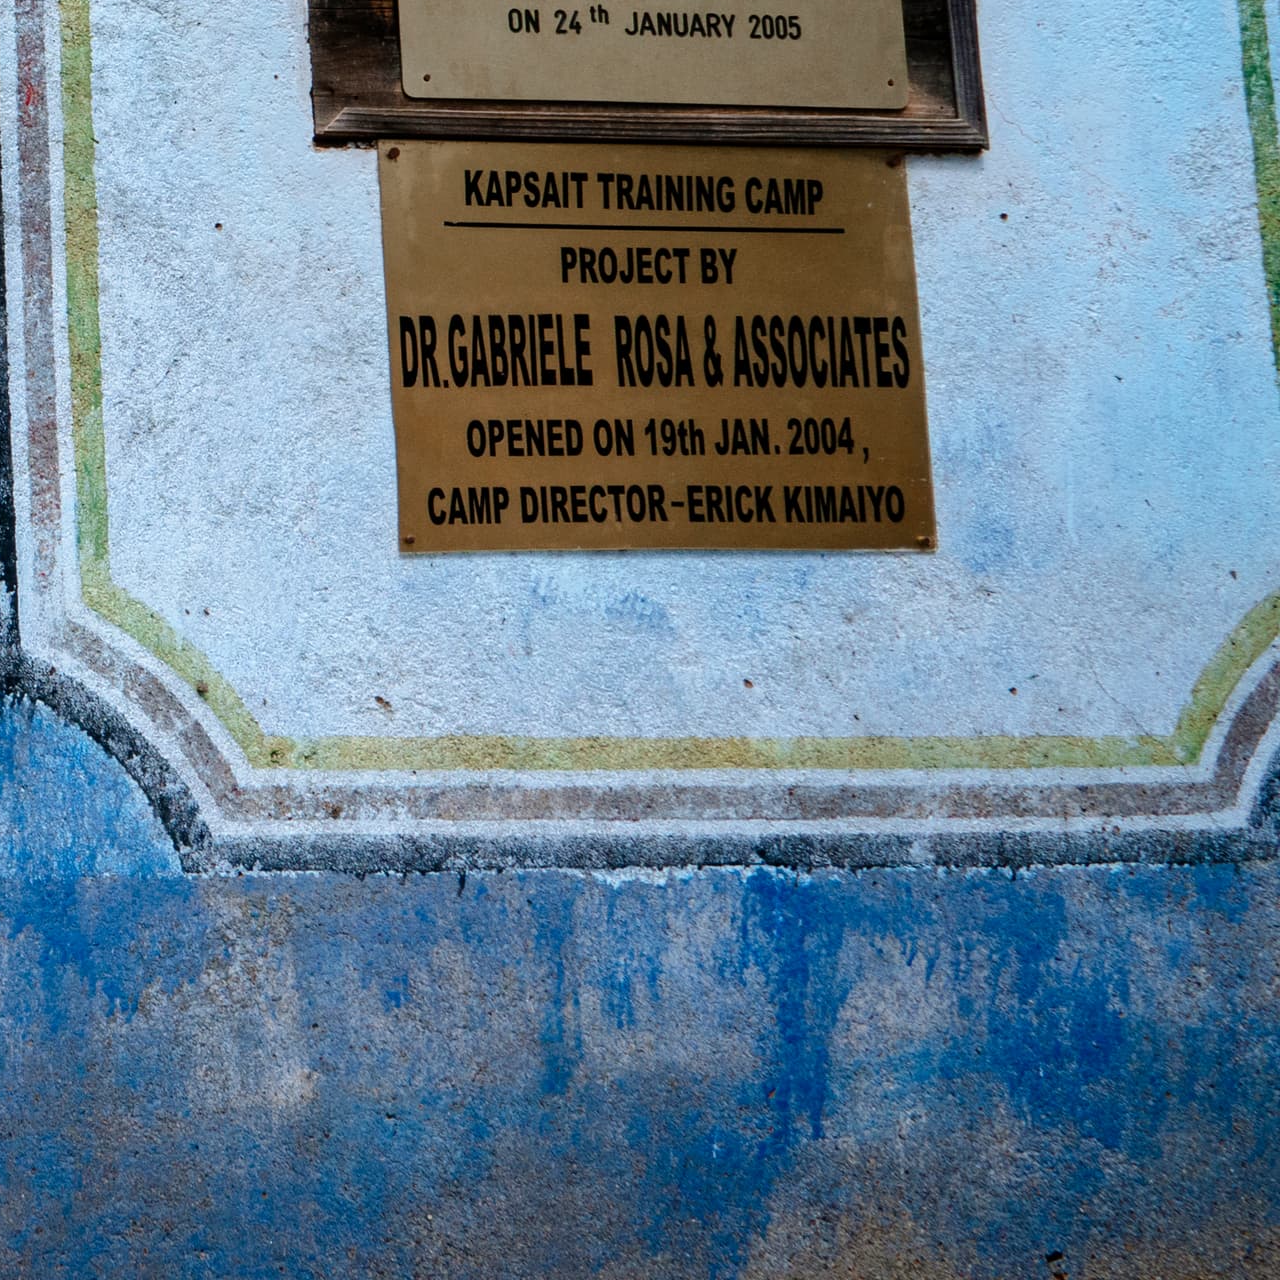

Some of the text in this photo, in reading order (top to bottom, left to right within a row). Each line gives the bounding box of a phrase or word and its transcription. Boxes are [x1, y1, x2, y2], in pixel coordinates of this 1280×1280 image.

[507, 8, 541, 34] ON
[624, 11, 736, 38] JANUARY
[748, 14, 802, 41] 2005
[464, 169, 824, 216] KAPSAIT TRAINING CAMP
[560, 246, 738, 285] PROJECT BY
[614, 314, 696, 388] ROSA
[703, 314, 724, 388] &
[733, 314, 910, 389] ASSOCIATES
[466, 419, 584, 458] OPENED
[593, 418, 636, 457] ON
[644, 418, 706, 457] 19th
[714, 418, 781, 456] JAN.
[427, 486, 510, 526] CAMP
[783, 485, 906, 524] KIMAIYO
